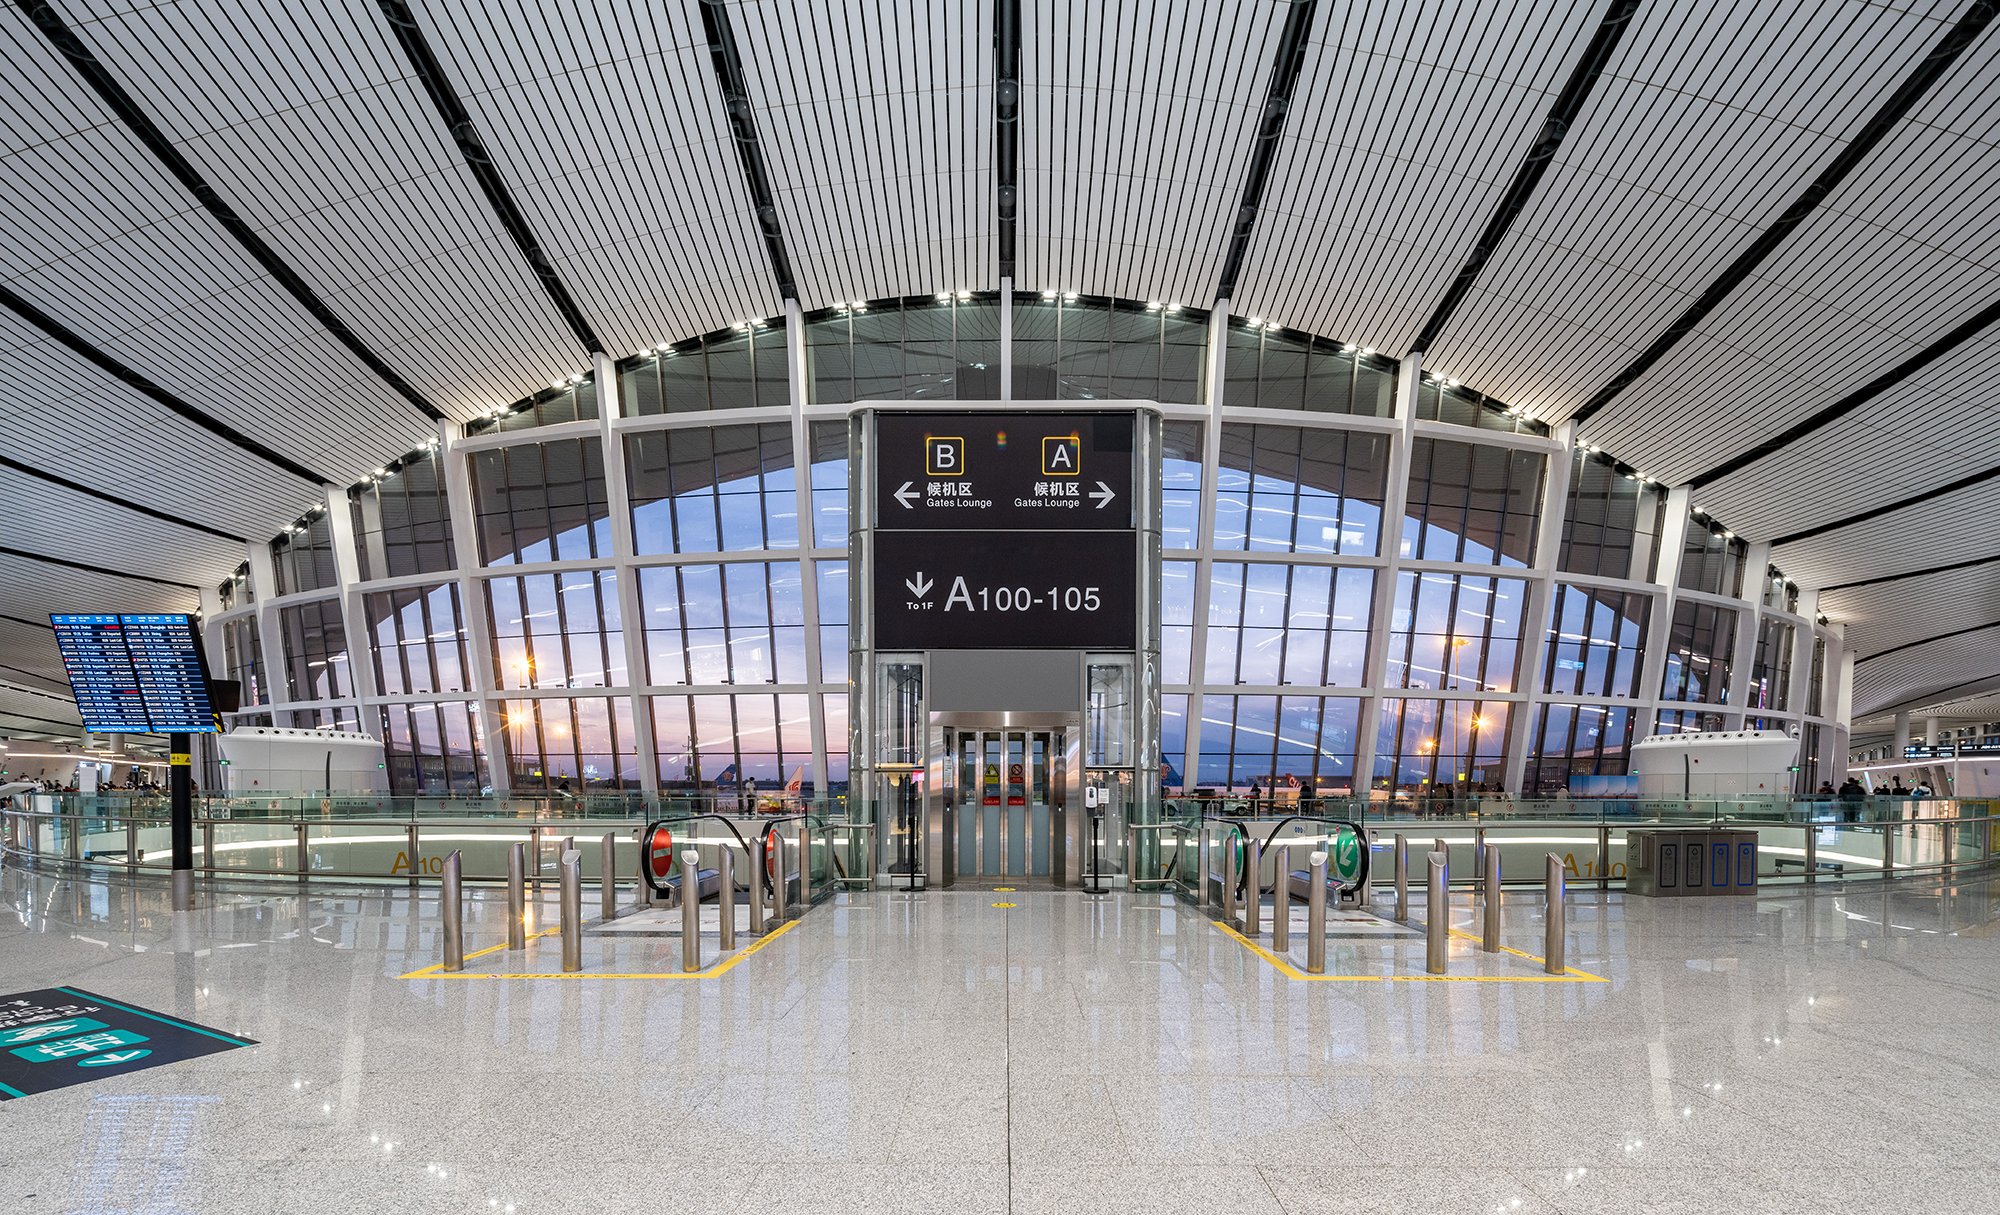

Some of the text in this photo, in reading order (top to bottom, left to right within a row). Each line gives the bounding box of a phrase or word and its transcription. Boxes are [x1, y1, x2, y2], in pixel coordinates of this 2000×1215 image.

[936, 444, 955, 468] B
[1051, 444, 1072, 468] A
[927, 482, 972, 496] 候机区
[1034, 482, 1079, 496] 候机区
[927, 498, 992, 508] Gates Lounge
[1014, 498, 1079, 508] Gates Lounge
[38, 1036, 125, 1057] 出
